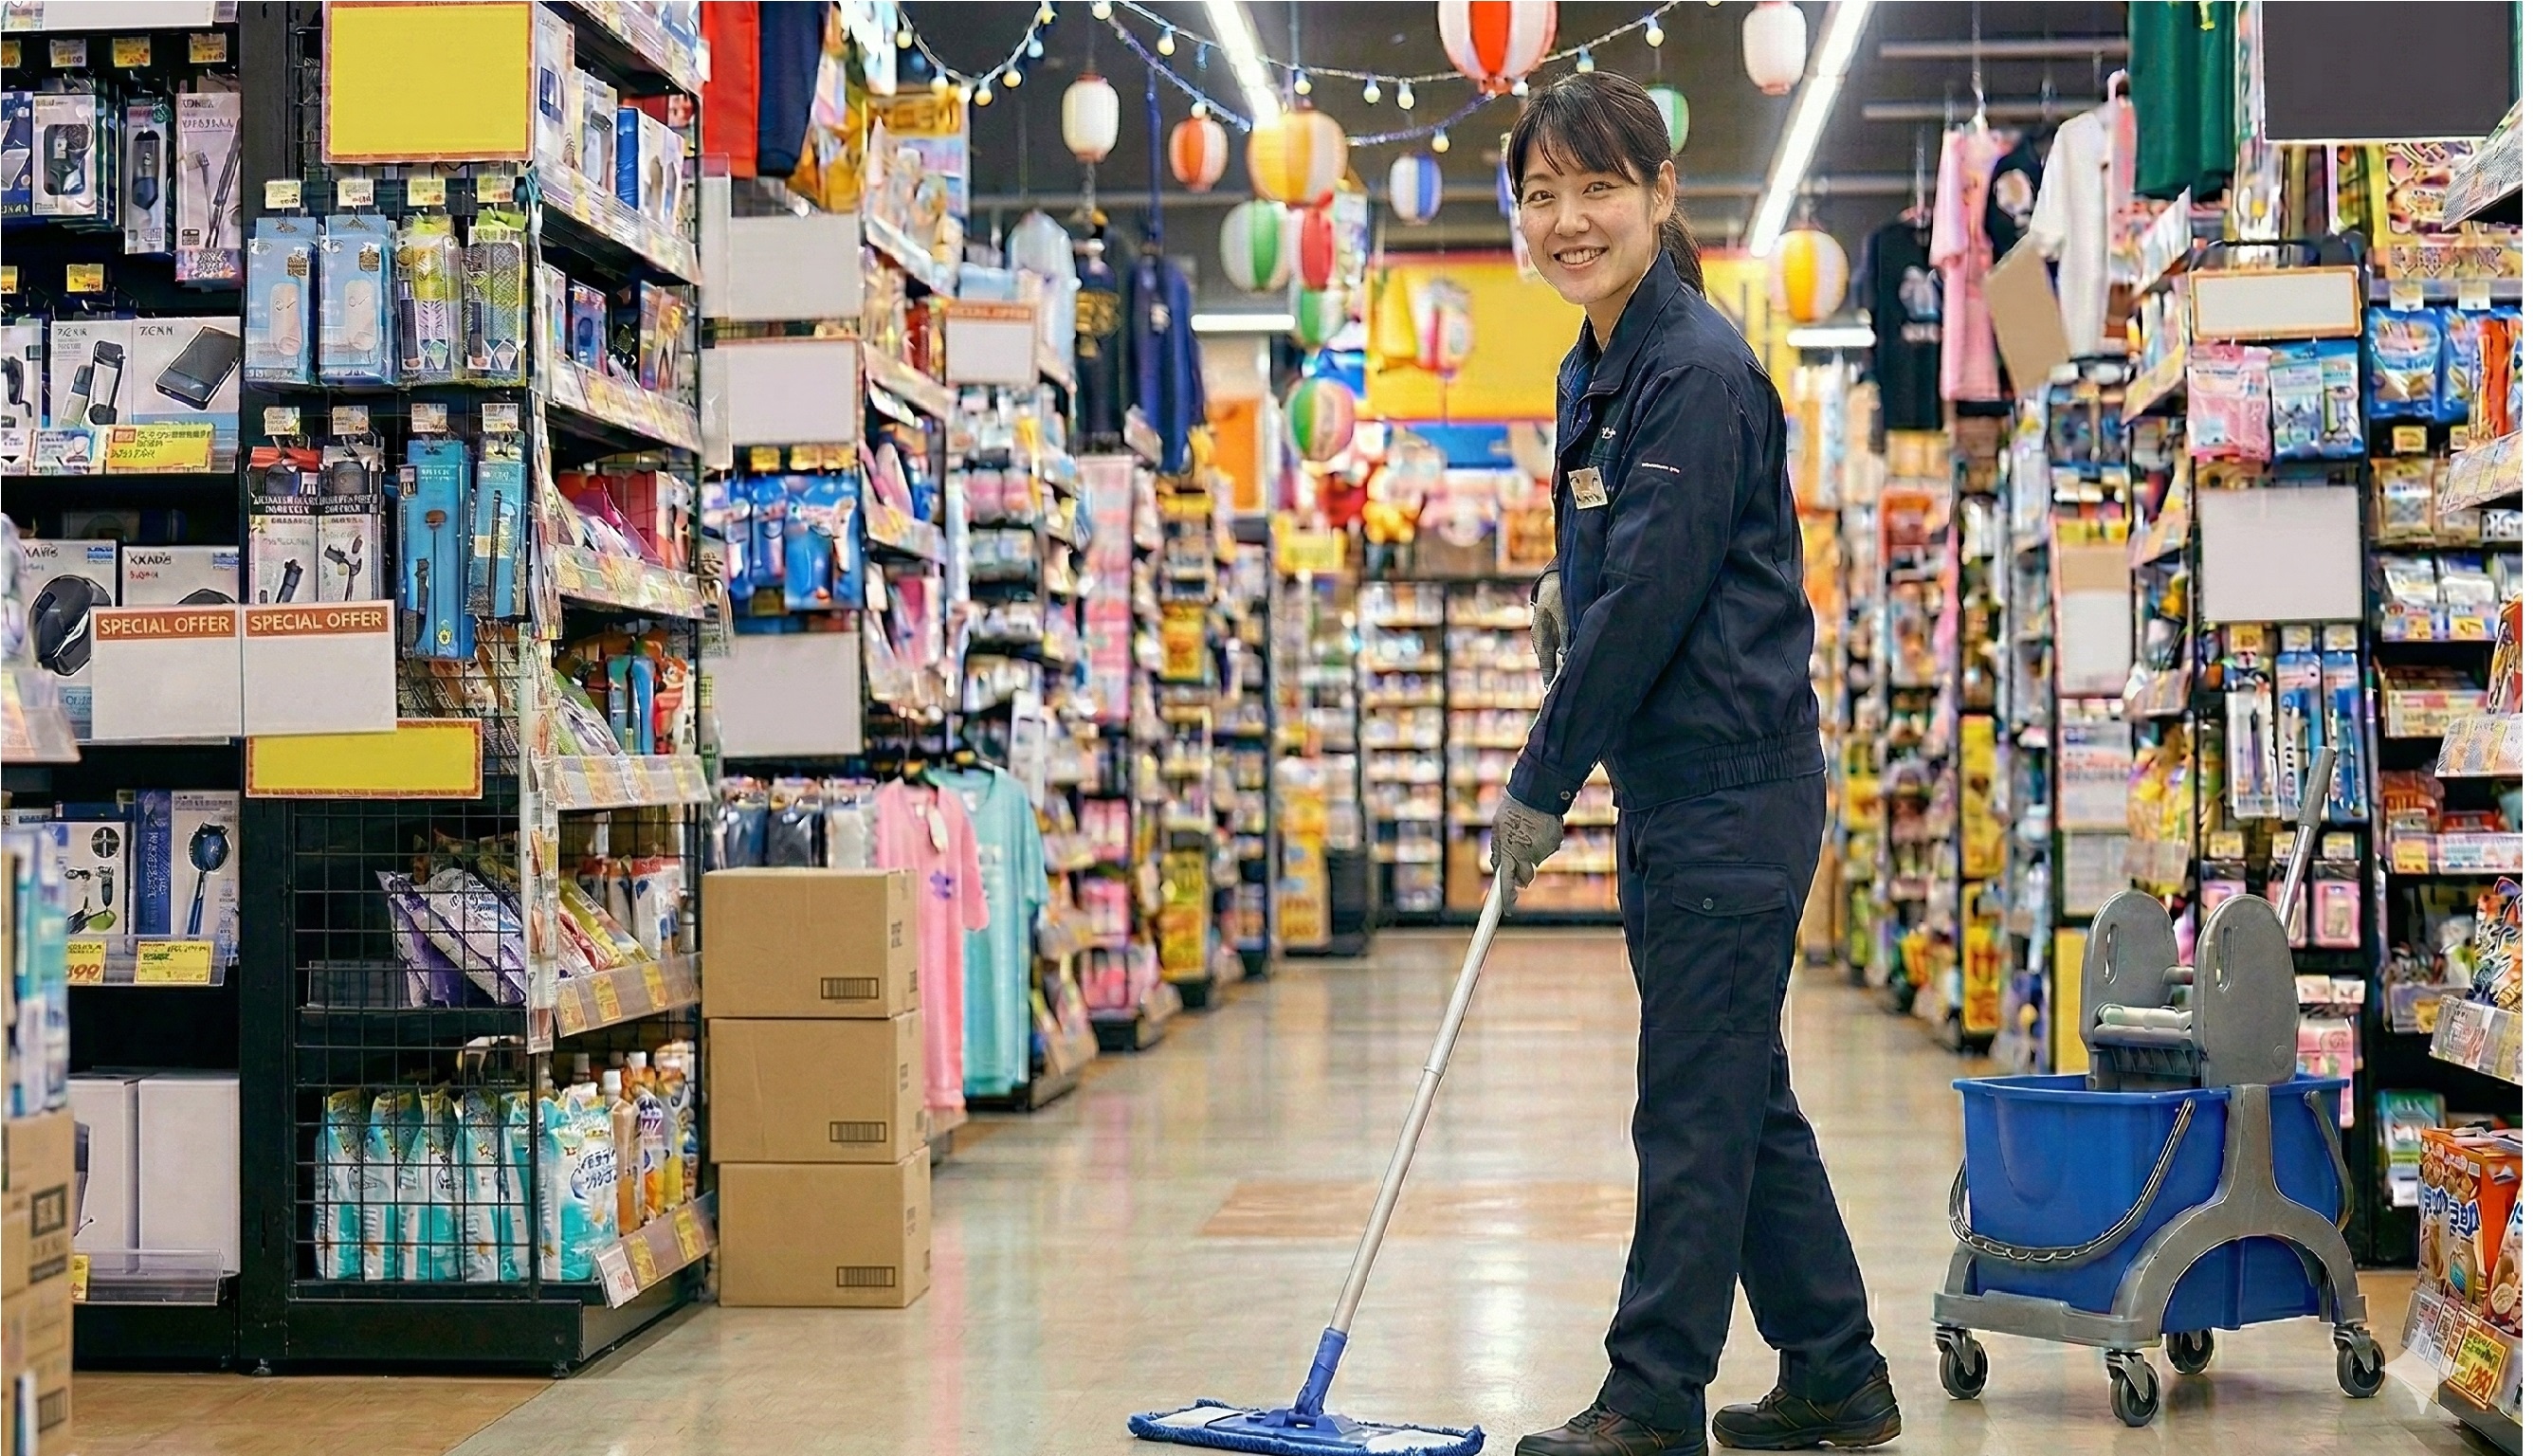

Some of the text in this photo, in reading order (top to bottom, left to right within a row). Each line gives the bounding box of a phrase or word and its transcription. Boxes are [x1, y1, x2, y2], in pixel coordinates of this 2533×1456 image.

[100, 615, 229, 635] SPECIAL OFFER
[250, 610, 382, 631] SPECIAL OFFER
